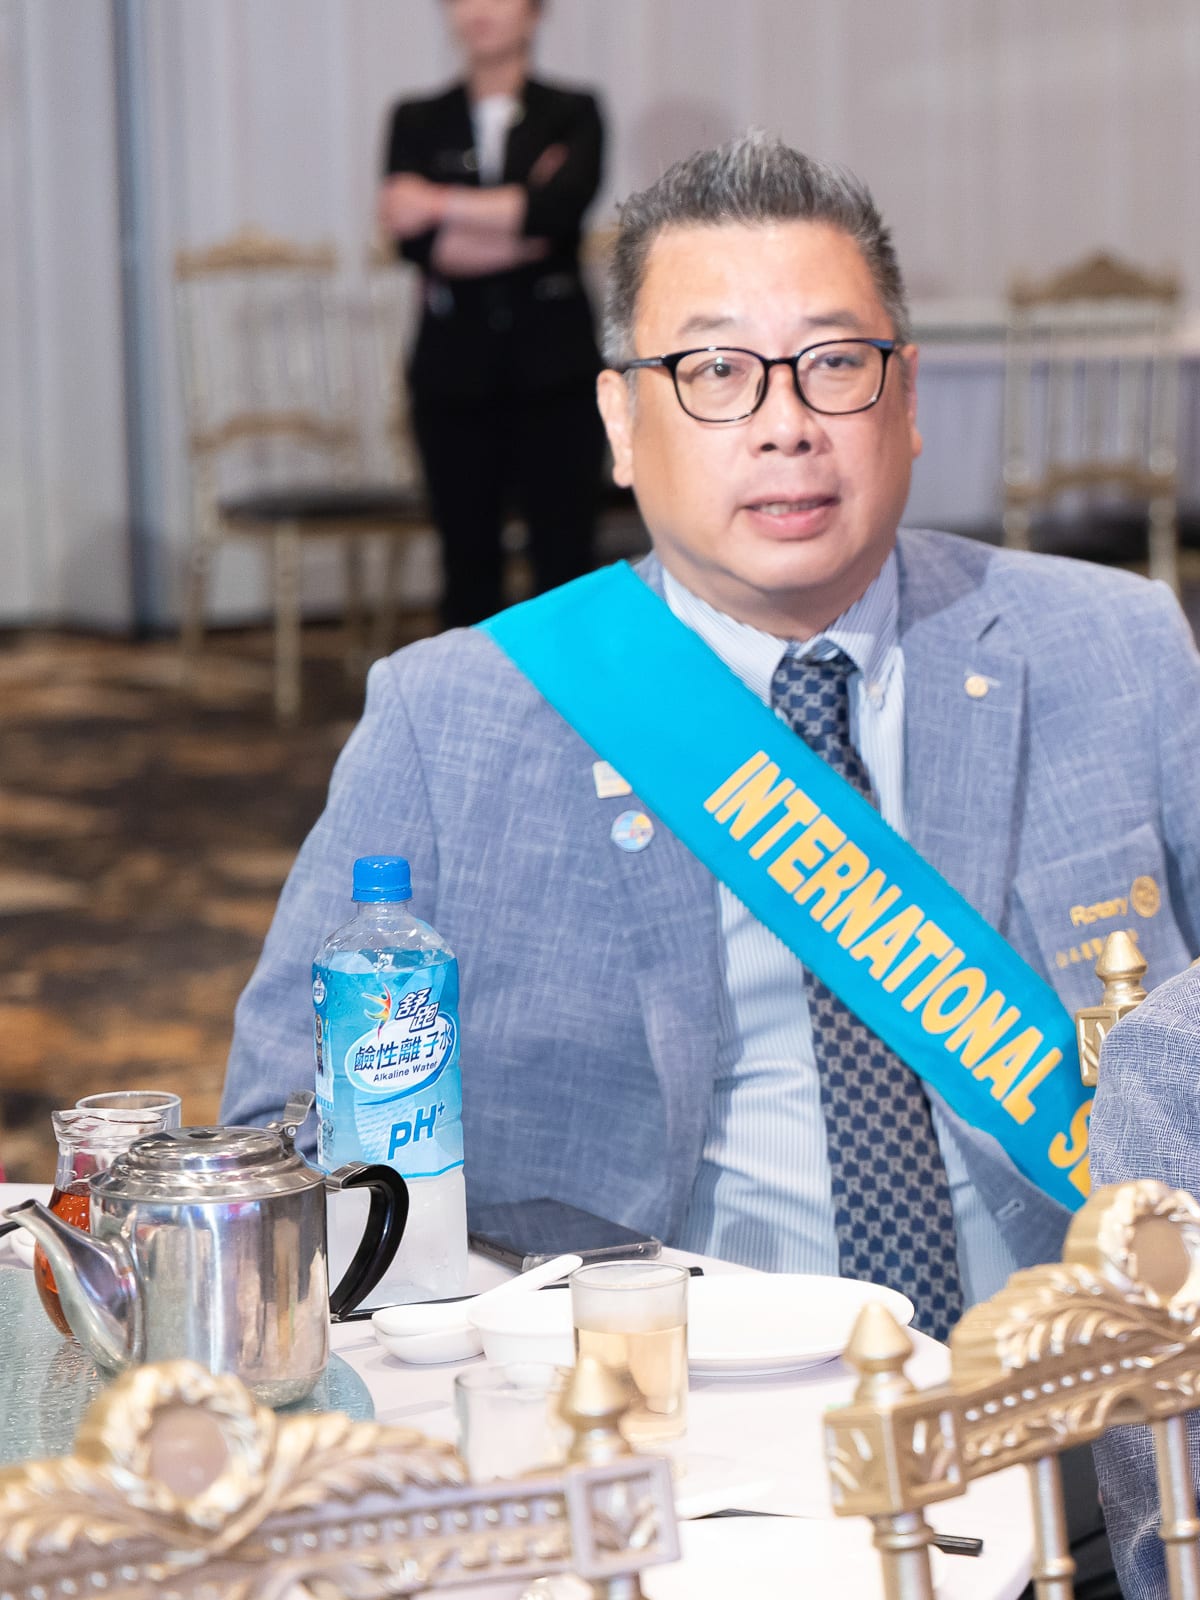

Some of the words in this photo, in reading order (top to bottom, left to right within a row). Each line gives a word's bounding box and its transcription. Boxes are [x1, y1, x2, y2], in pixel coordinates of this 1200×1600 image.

[703, 750, 1063, 1125] INTERNATIONAL
[1048, 1100, 1094, 1199] S
[395, 987, 440, 1033] 舒跑
[353, 1024, 453, 1072] 鹼性離子水
[373, 1068, 410, 1082] Alkaline
[412, 1060, 438, 1074] Water
